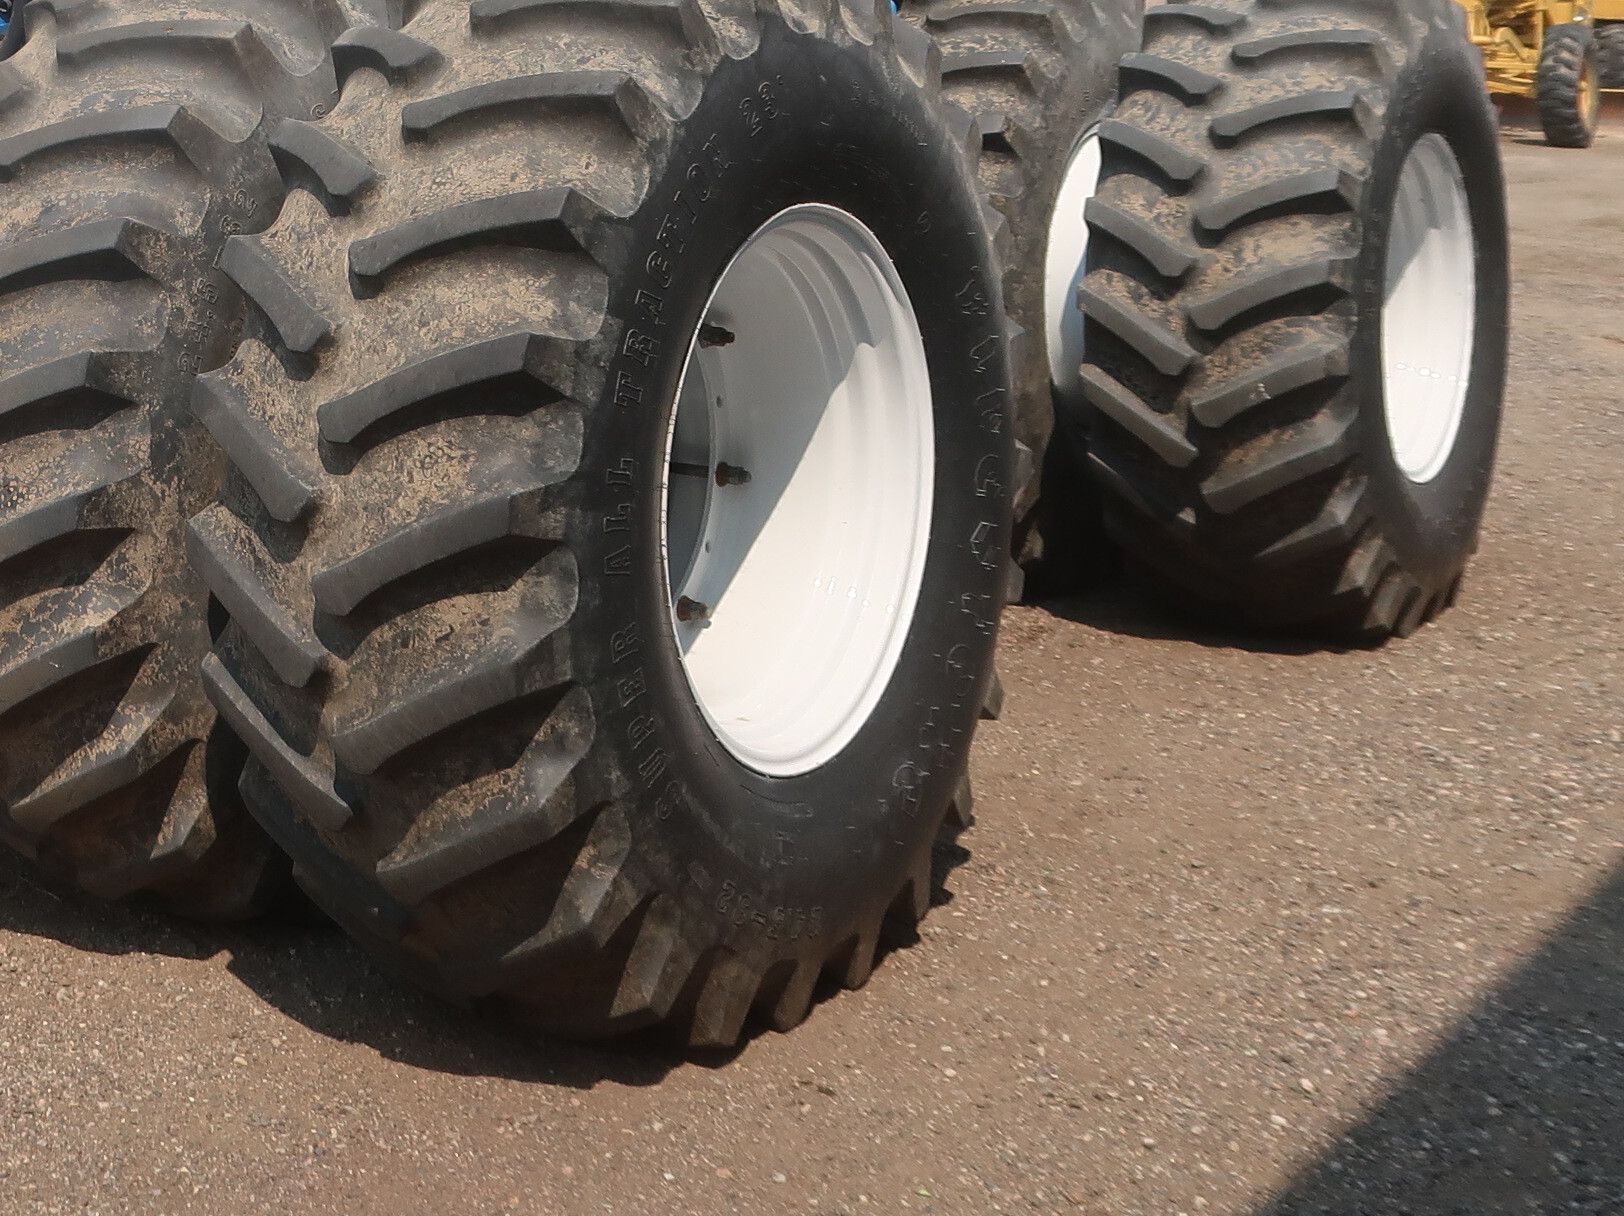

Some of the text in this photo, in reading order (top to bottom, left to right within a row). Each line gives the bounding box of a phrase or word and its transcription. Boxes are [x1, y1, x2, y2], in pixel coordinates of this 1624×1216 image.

[613, 132, 733, 406] TRACTION
[603, 456, 639, 575] ALL
[609, 622, 679, 822] SUPER
